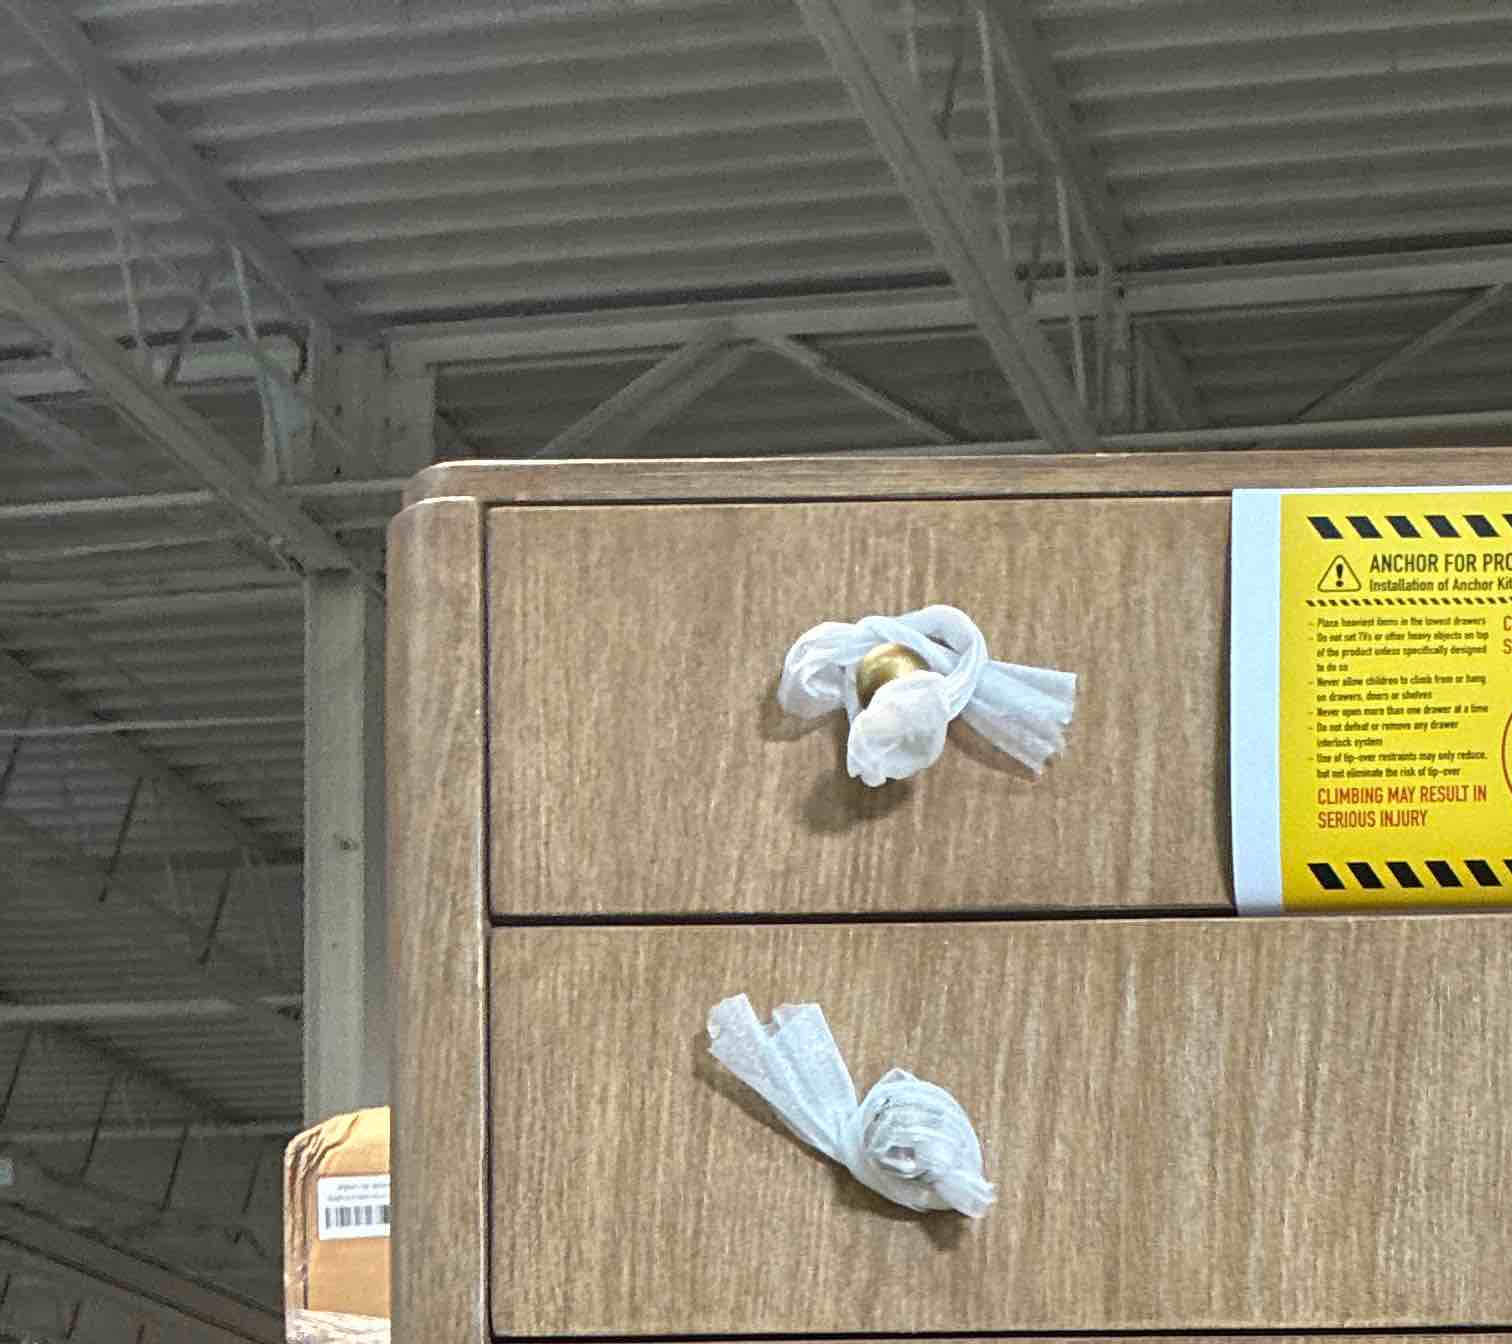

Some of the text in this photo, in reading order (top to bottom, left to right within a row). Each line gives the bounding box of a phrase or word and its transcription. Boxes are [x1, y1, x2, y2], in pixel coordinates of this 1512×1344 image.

[1370, 553, 1438, 573] ANCHOR
[1443, 553, 1476, 572] FOR
[1368, 577, 1434, 592] Installation
[1437, 578, 1449, 591] of
[1452, 577, 1493, 591] Anchor
[1496, 576, 1512, 590] Kit
[1316, 784, 1487, 805] CLIMBING MAY RESULT IN
[1317, 809, 1427, 828] SERIOUS INJURY
